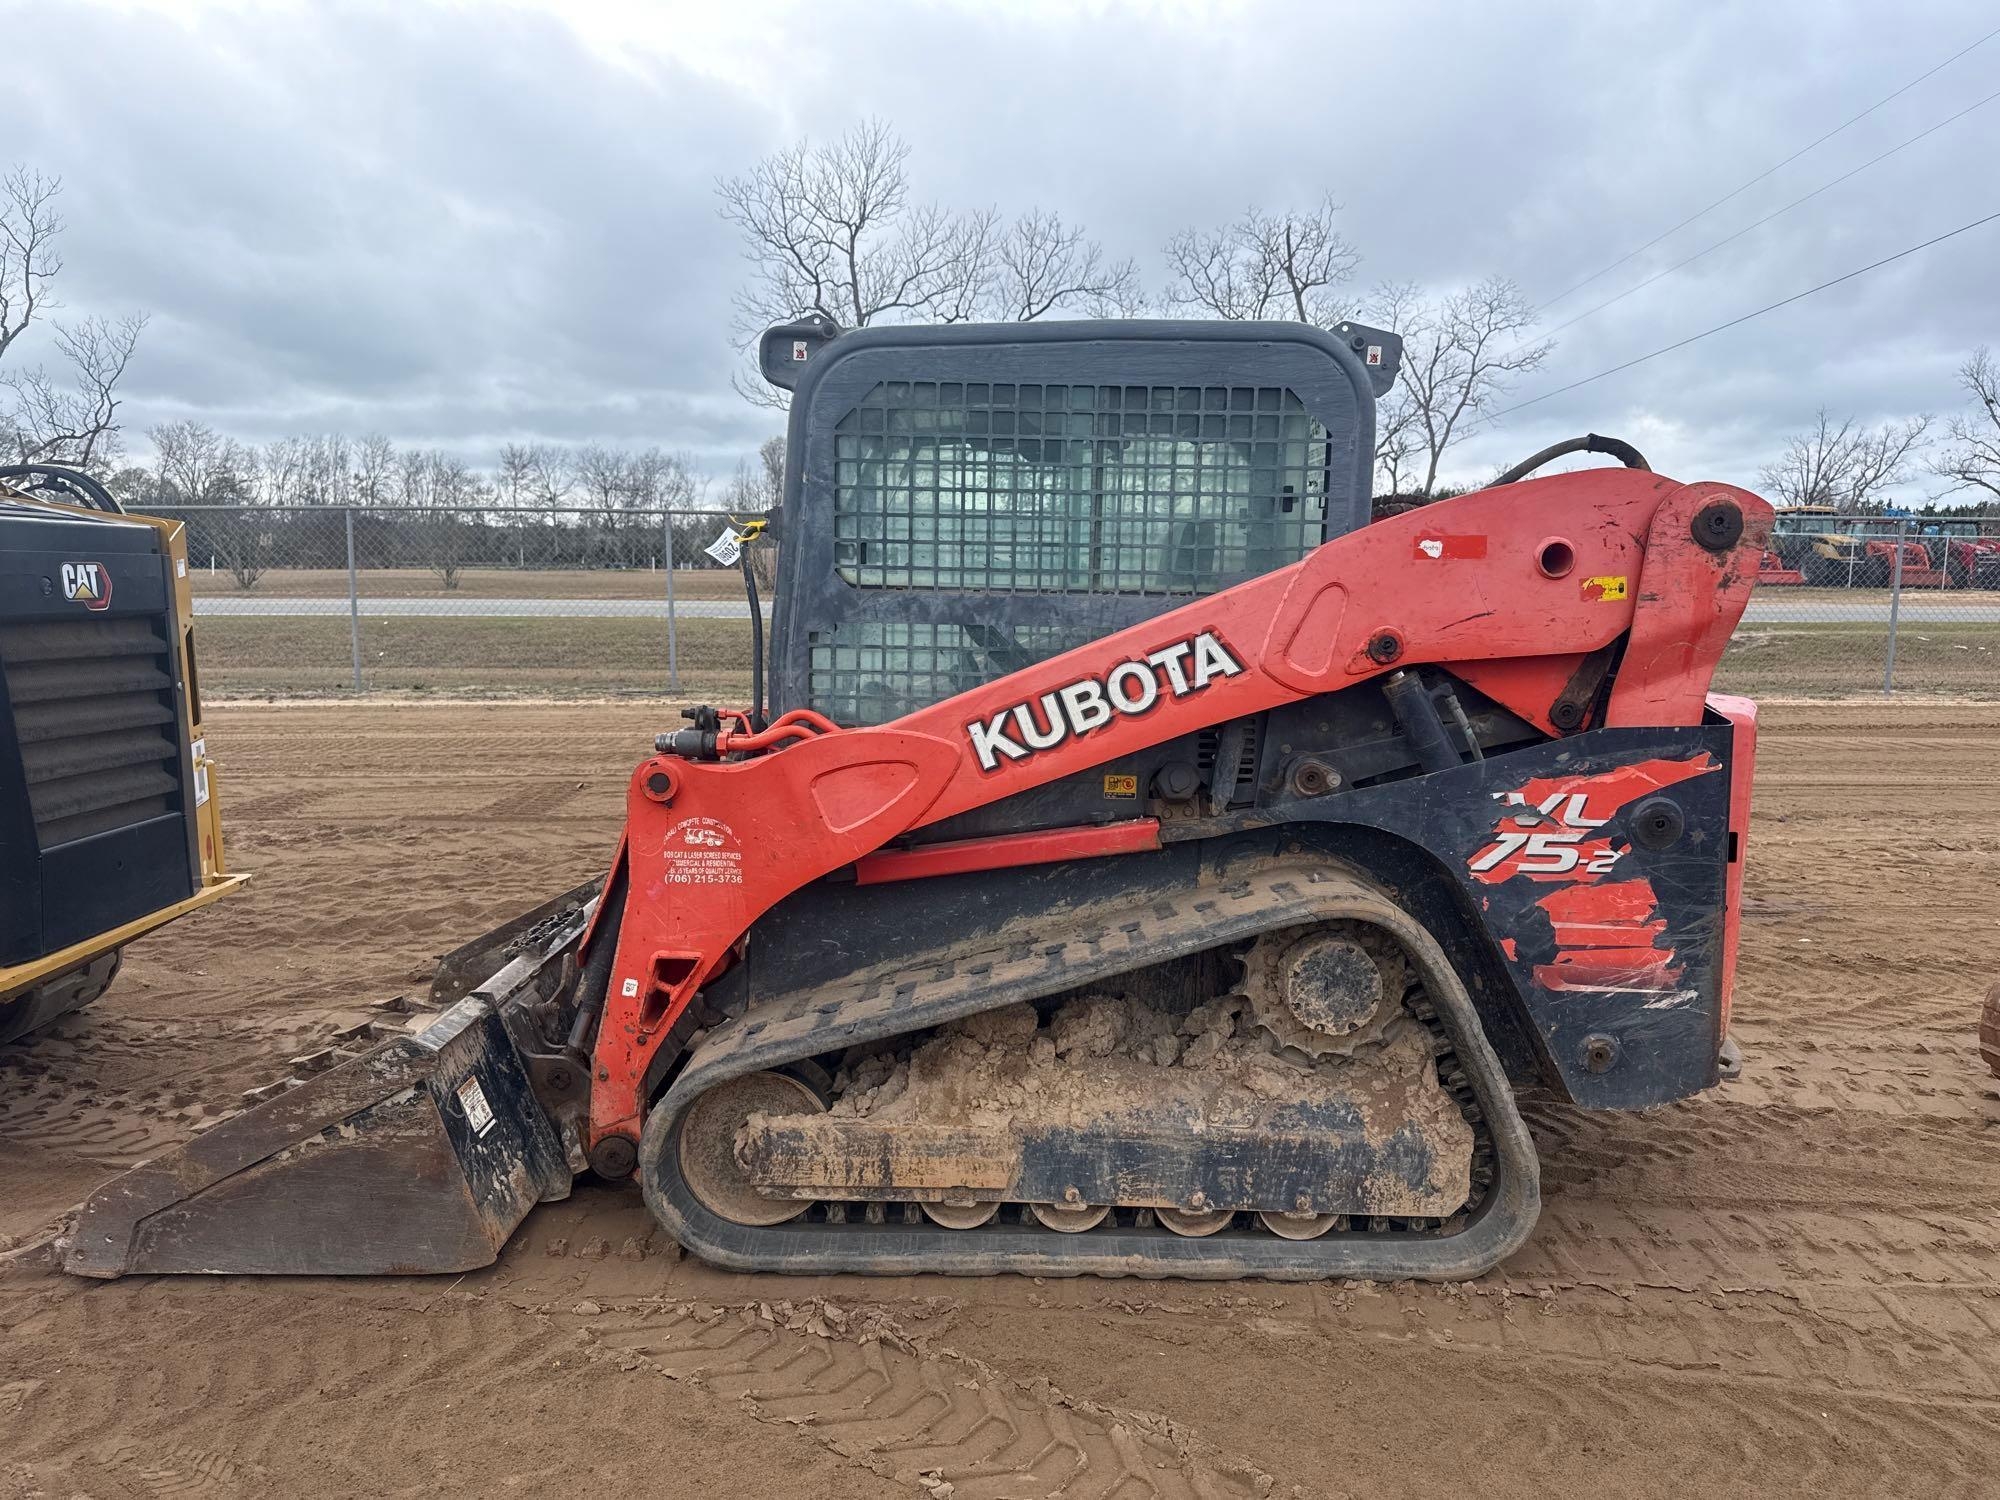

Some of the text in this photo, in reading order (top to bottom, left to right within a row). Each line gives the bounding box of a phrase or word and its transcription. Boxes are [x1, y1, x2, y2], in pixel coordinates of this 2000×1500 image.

[62, 563, 98, 599] CAT
[966, 632, 1243, 771] KUBOTA
[1490, 792, 1611, 827] VL
[670, 859, 701, 867] MMERCIAL
[688, 851, 703, 859] LASER
[1470, 832, 1624, 873] 75-2
[664, 874, 743, 884] (706) 215-3736
